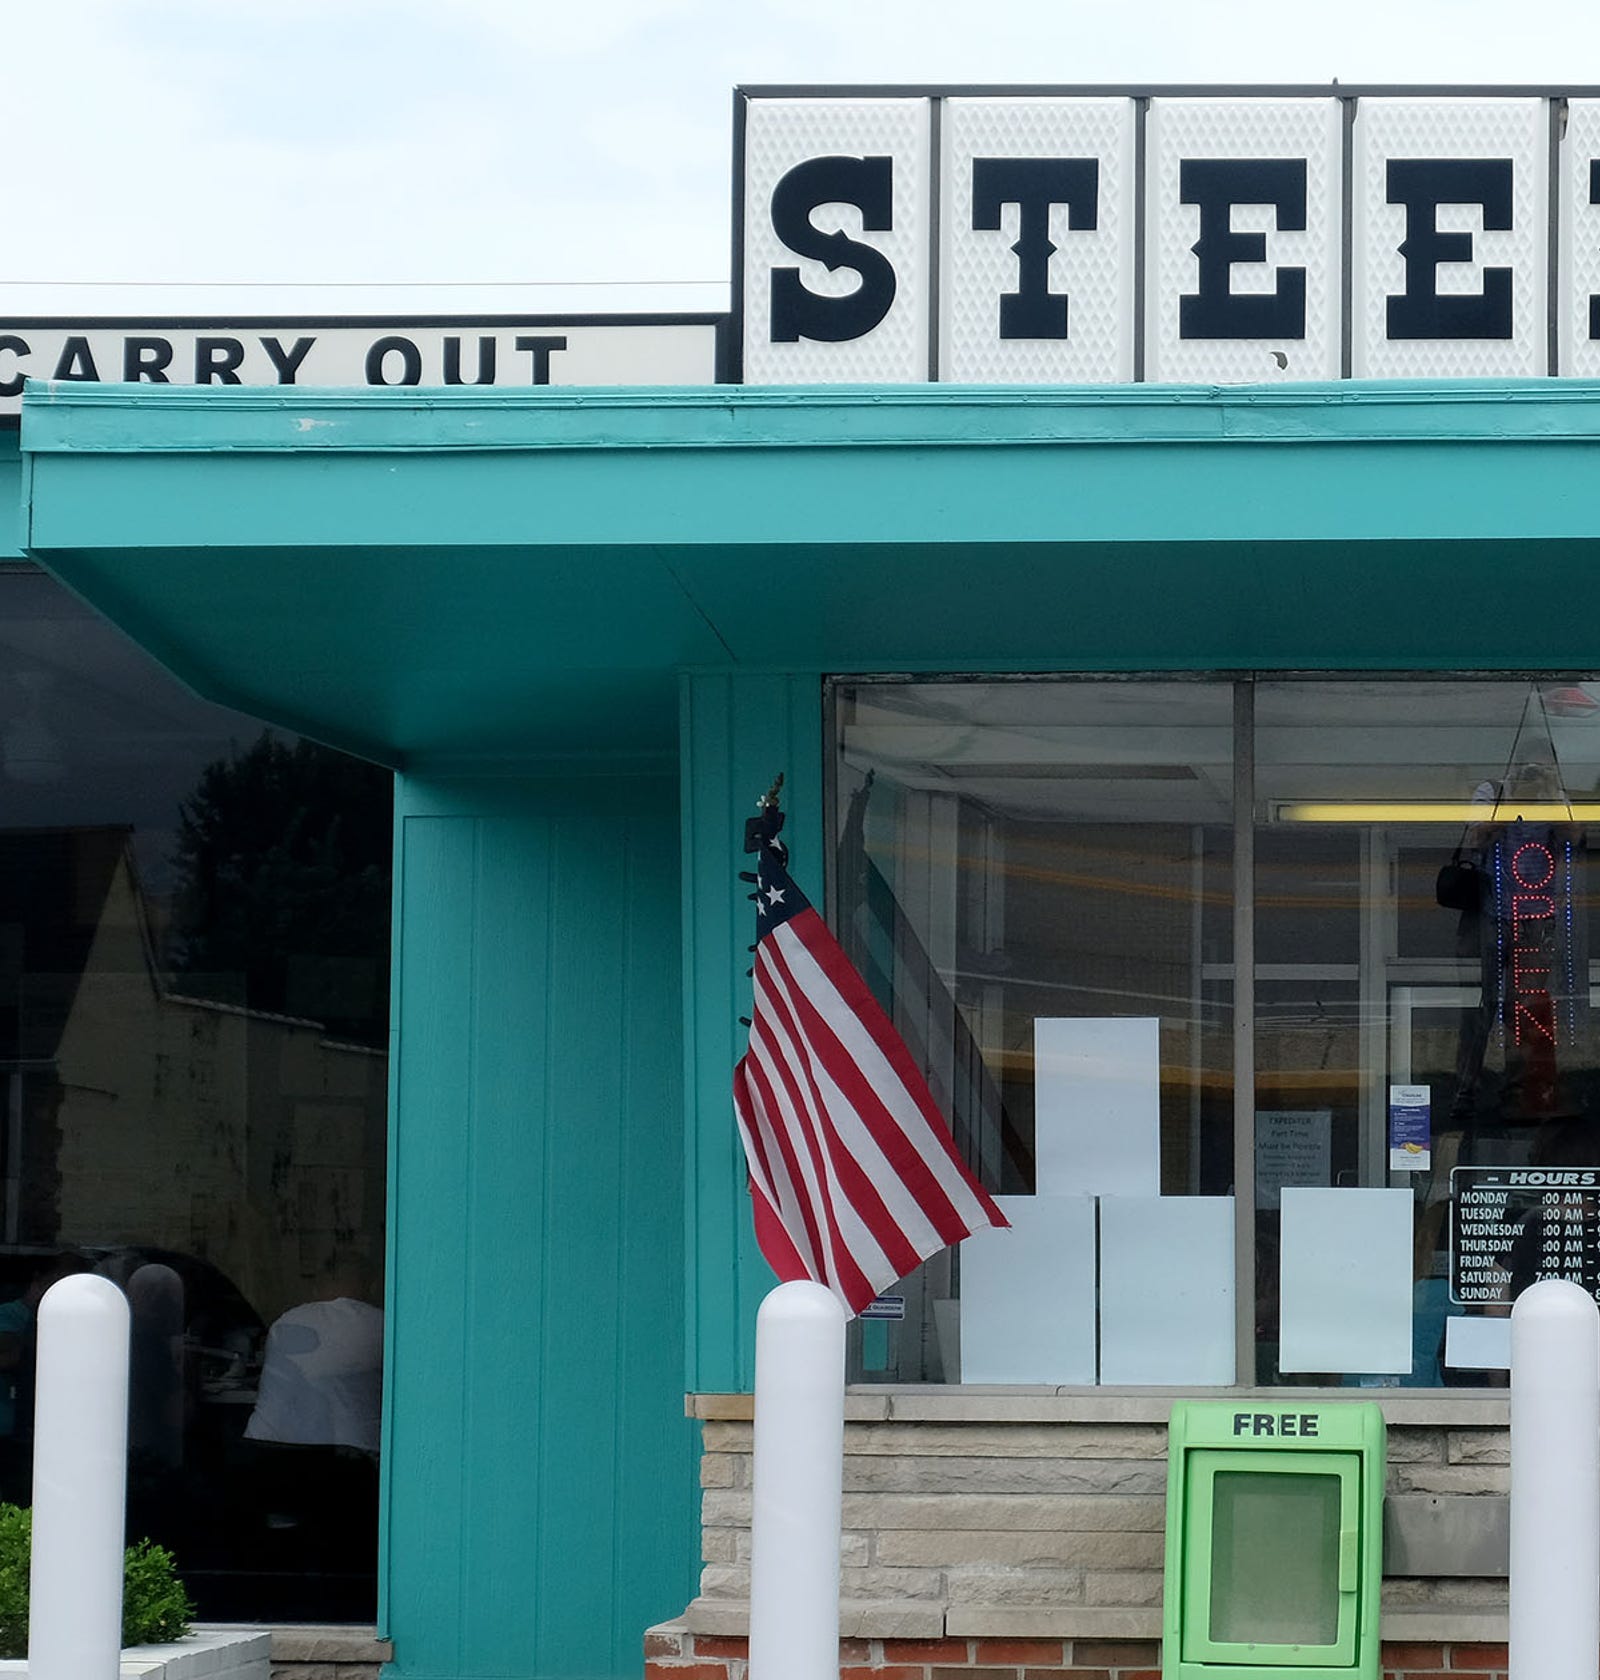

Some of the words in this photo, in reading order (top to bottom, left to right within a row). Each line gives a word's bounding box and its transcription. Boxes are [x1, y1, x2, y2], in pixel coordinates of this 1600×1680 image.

[0, 335, 317, 397] CARRY
[365, 336, 568, 385] OUT
[1512, 842, 1557, 1046] OPEN
[1509, 1172, 1596, 1185] HOURS
[1460, 1192, 1508, 1204] MONDAY
[1564, 1193, 1583, 1205] AM
[1460, 1208, 1505, 1220] TUESDAY
[1564, 1209, 1583, 1221] AM
[1460, 1224, 1525, 1236] WEDNESDAY
[1564, 1225, 1583, 1237] AM
[1460, 1240, 1514, 1252] THURSDAY
[1564, 1241, 1583, 1252] AM
[1460, 1256, 1495, 1268] FRIDAY
[1564, 1257, 1583, 1268] AM
[1460, 1272, 1513, 1284] SATURDAY
[1564, 1273, 1583, 1284] AM
[1460, 1288, 1502, 1300] SUNDAY
[1233, 1414, 1319, 1437] FREE
